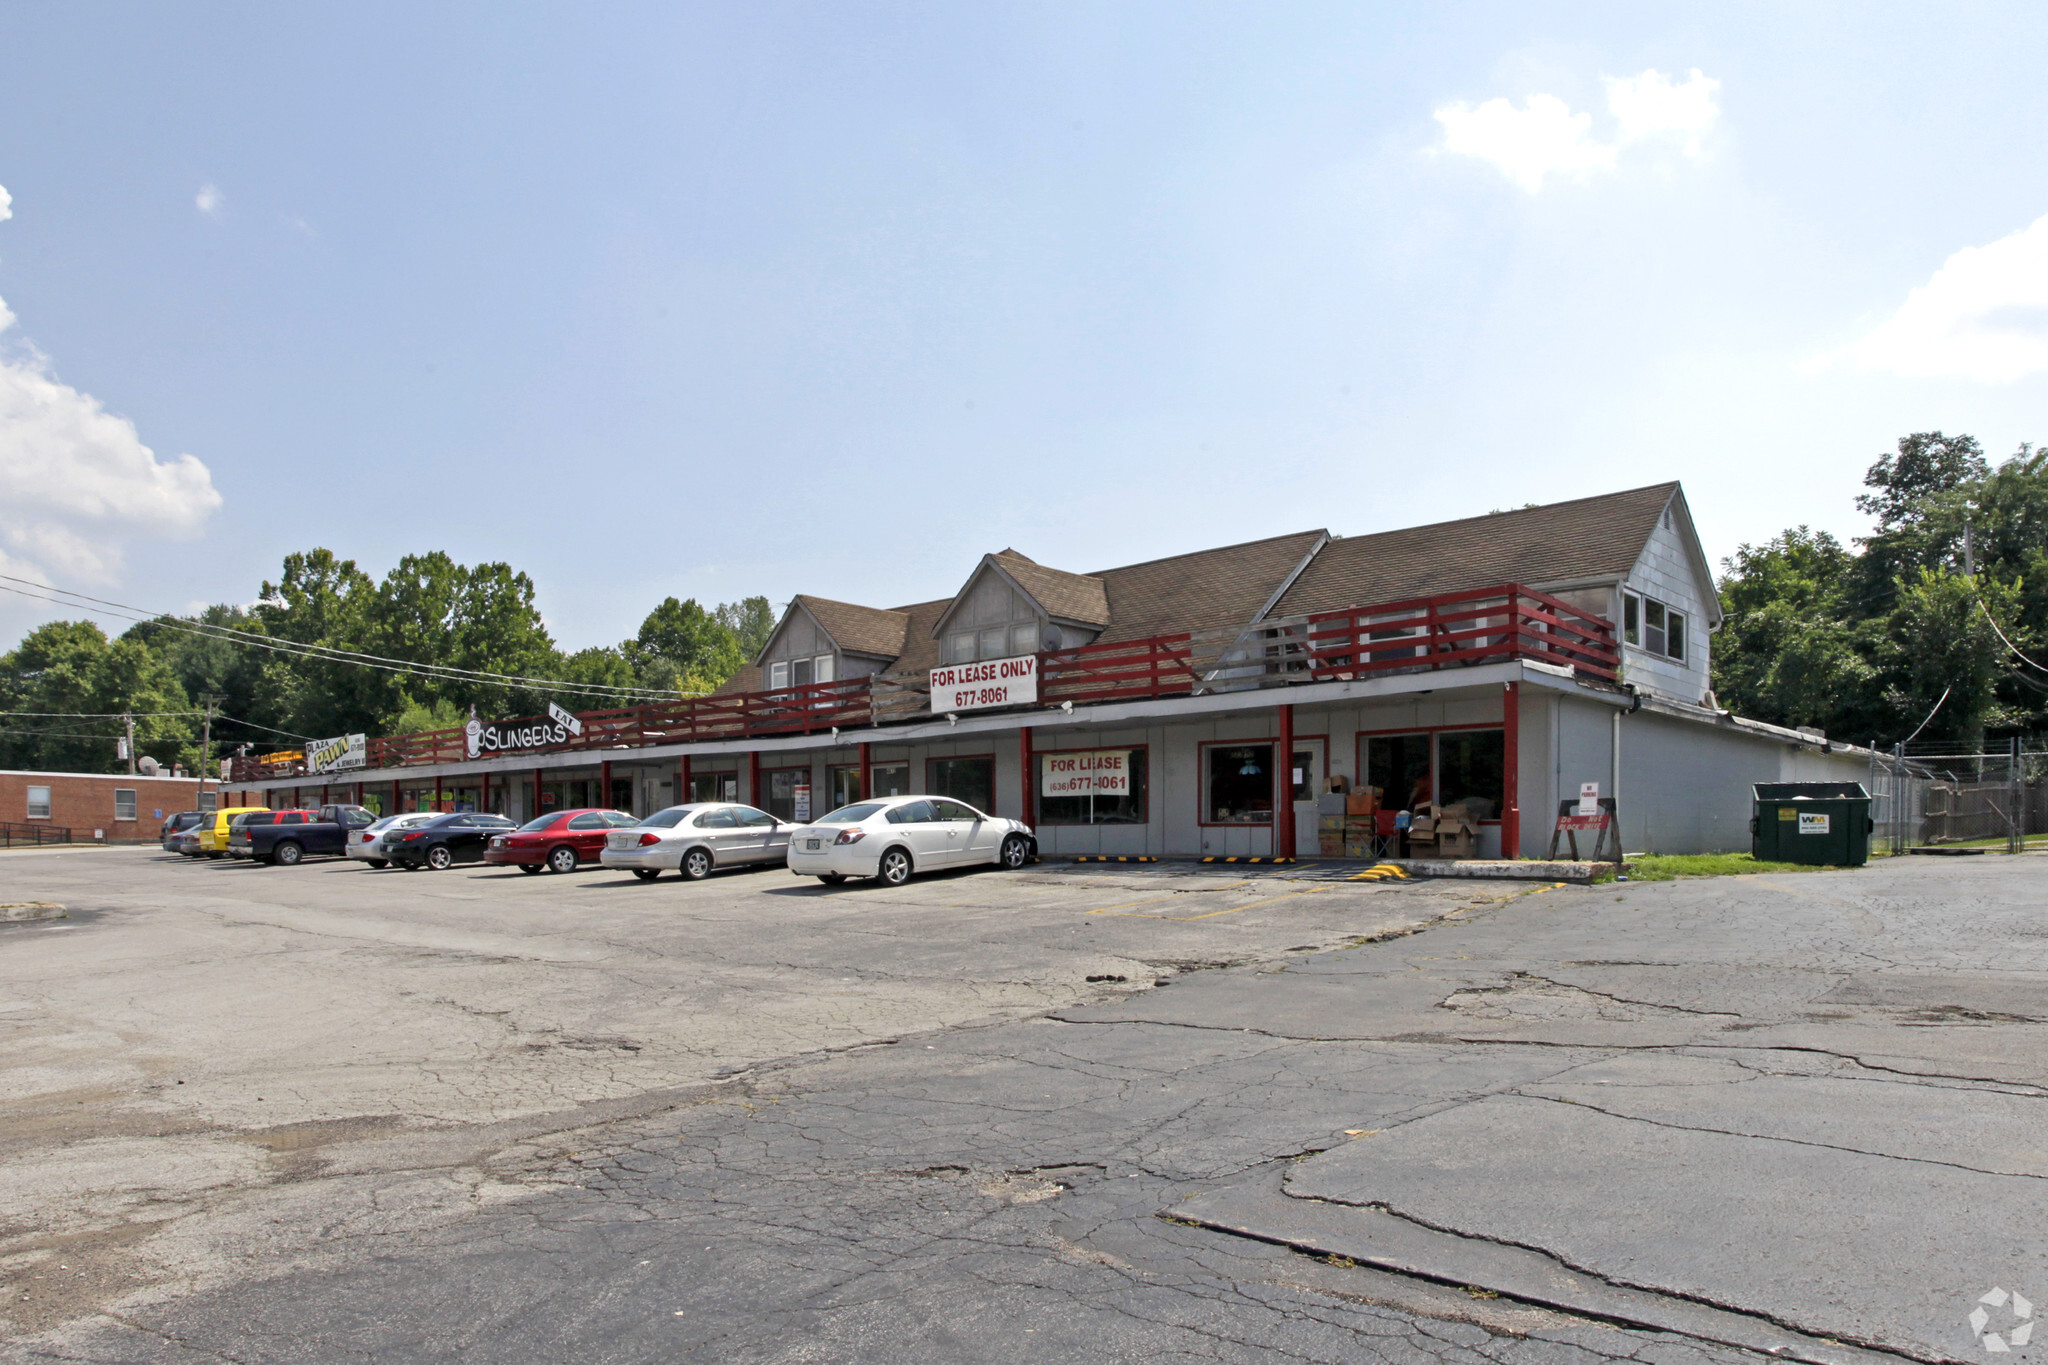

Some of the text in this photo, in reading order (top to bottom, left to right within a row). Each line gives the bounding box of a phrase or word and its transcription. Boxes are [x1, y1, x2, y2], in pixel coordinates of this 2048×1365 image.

[931, 659, 1034, 687] FOR LEASE ONLY
[955, 686, 1008, 707] 677-8061
[555, 710, 574, 727] EAT
[485, 724, 566, 750] SLINGERS
[306, 740, 329, 757] PLAZA
[314, 736, 349, 773] PAWN
[1050, 757, 1122, 772] FOR LEASE
